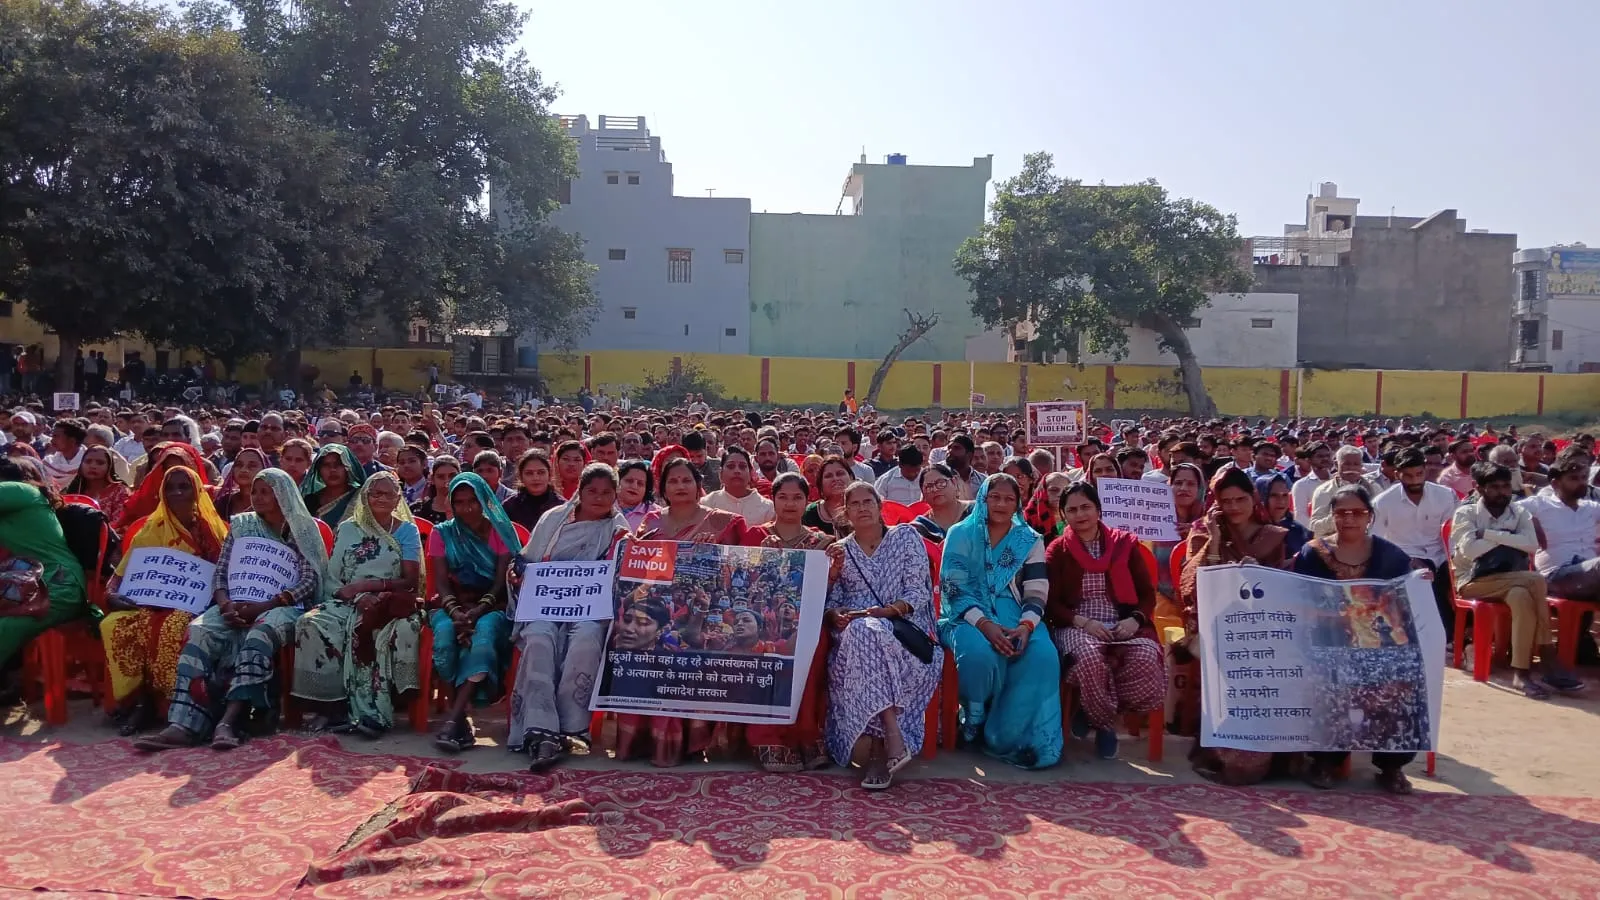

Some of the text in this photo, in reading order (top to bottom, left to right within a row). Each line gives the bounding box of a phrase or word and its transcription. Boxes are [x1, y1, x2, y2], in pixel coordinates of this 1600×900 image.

[630, 546, 663, 557] SAVE
[144, 556, 160, 564] हम
[161, 555, 188, 572] हिन्दू
[260, 558, 271, 568] को
[536, 563, 610, 577] बांग्लादेश में
[628, 559, 667, 571] HINDU
[130, 570, 208, 591] हम हिन्दुओं को
[126, 588, 162, 598] बचाकर
[536, 582, 603, 600] हिन्दुओं को
[1225, 610, 1296, 624] शांतिपूर्ण तरीके
[1225, 630, 1234, 642] से
[1225, 647, 1275, 661] करने वाले
[634, 652, 656, 664] समेत
[658, 654, 674, 665] वहां
[676, 656, 688, 666] रह
[690, 655, 702, 667] रहे
[704, 657, 759, 669] अल्पसंख्यकों
[761, 661, 773, 670] पर
[774, 660, 784, 671] हो
[613, 665, 773, 688] रहे अत्याचार के मामले को दबाने में जुटी
[1227, 665, 1304, 680] धार्मिक नेताओं
[656, 684, 728, 698] बांग्लादेश सरकार
[1227, 685, 1279, 698] से भयभीत
[1227, 705, 1312, 720] बांग्लादेश सरकार
